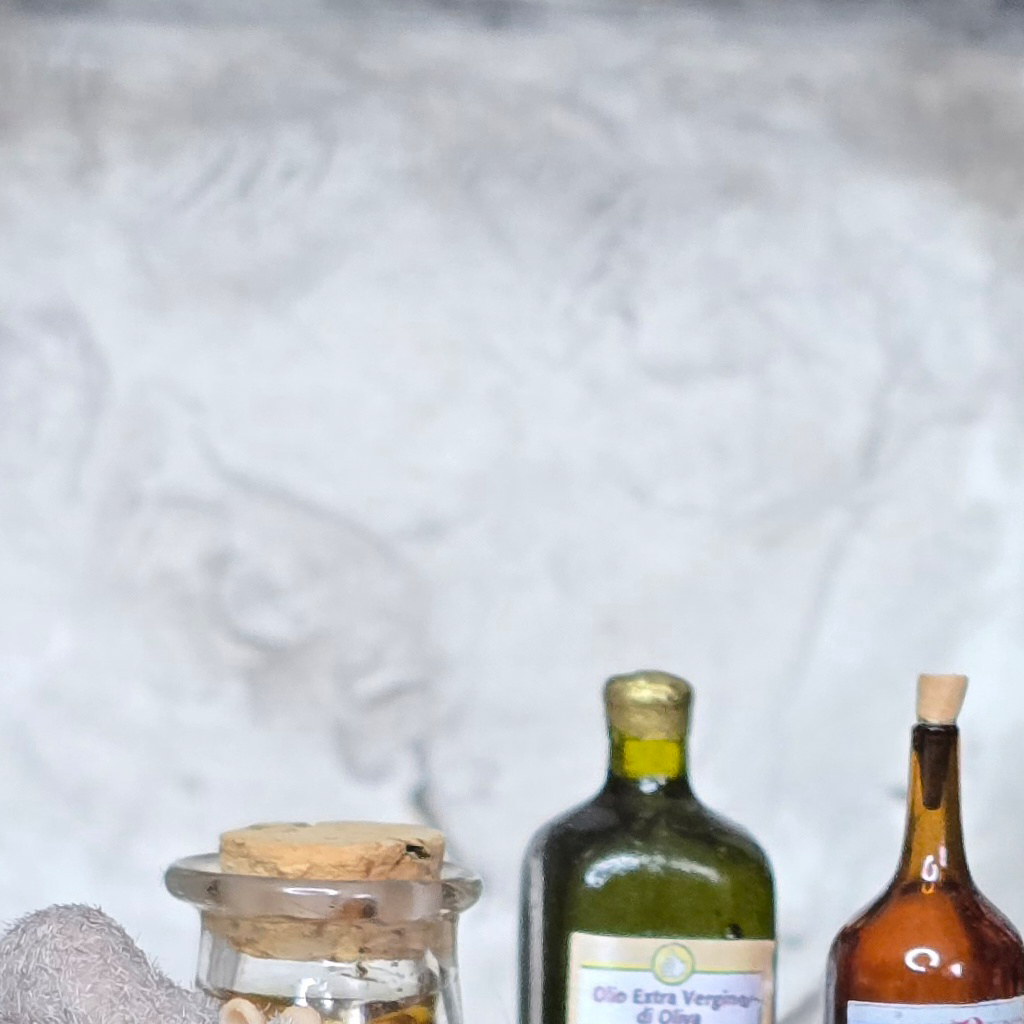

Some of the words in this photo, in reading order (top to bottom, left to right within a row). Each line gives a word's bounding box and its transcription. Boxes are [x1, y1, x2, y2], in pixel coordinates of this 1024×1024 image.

[593, 986, 627, 1004] Olio
[632, 988, 676, 1005] Extra
[636, 1008, 653, 1024] di
